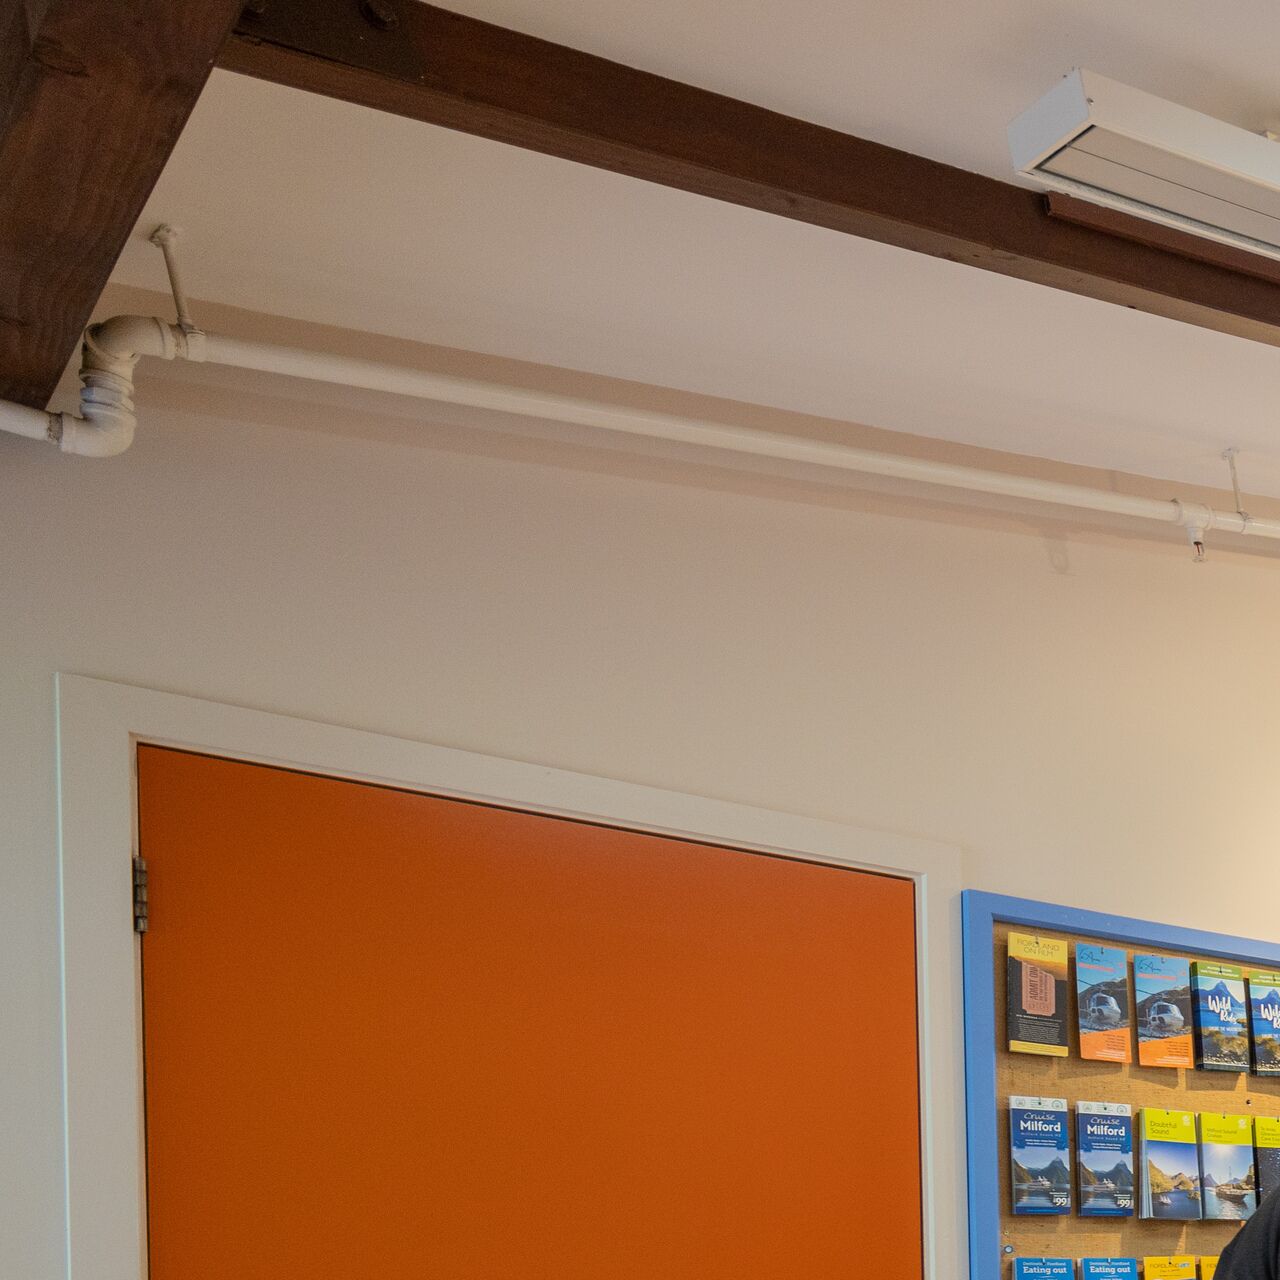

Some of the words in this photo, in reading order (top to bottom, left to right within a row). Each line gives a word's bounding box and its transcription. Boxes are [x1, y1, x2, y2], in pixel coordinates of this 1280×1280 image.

[1208, 995, 1232, 1013] Wild
[1023, 1111, 1056, 1120] Cruise
[1090, 1116, 1121, 1125] Cruise
[1020, 1120, 1061, 1132] Milford
[1087, 1124, 1126, 1136] Milford
[1023, 1266, 1051, 1275] Eating
[1089, 1265, 1116, 1274] Eating
